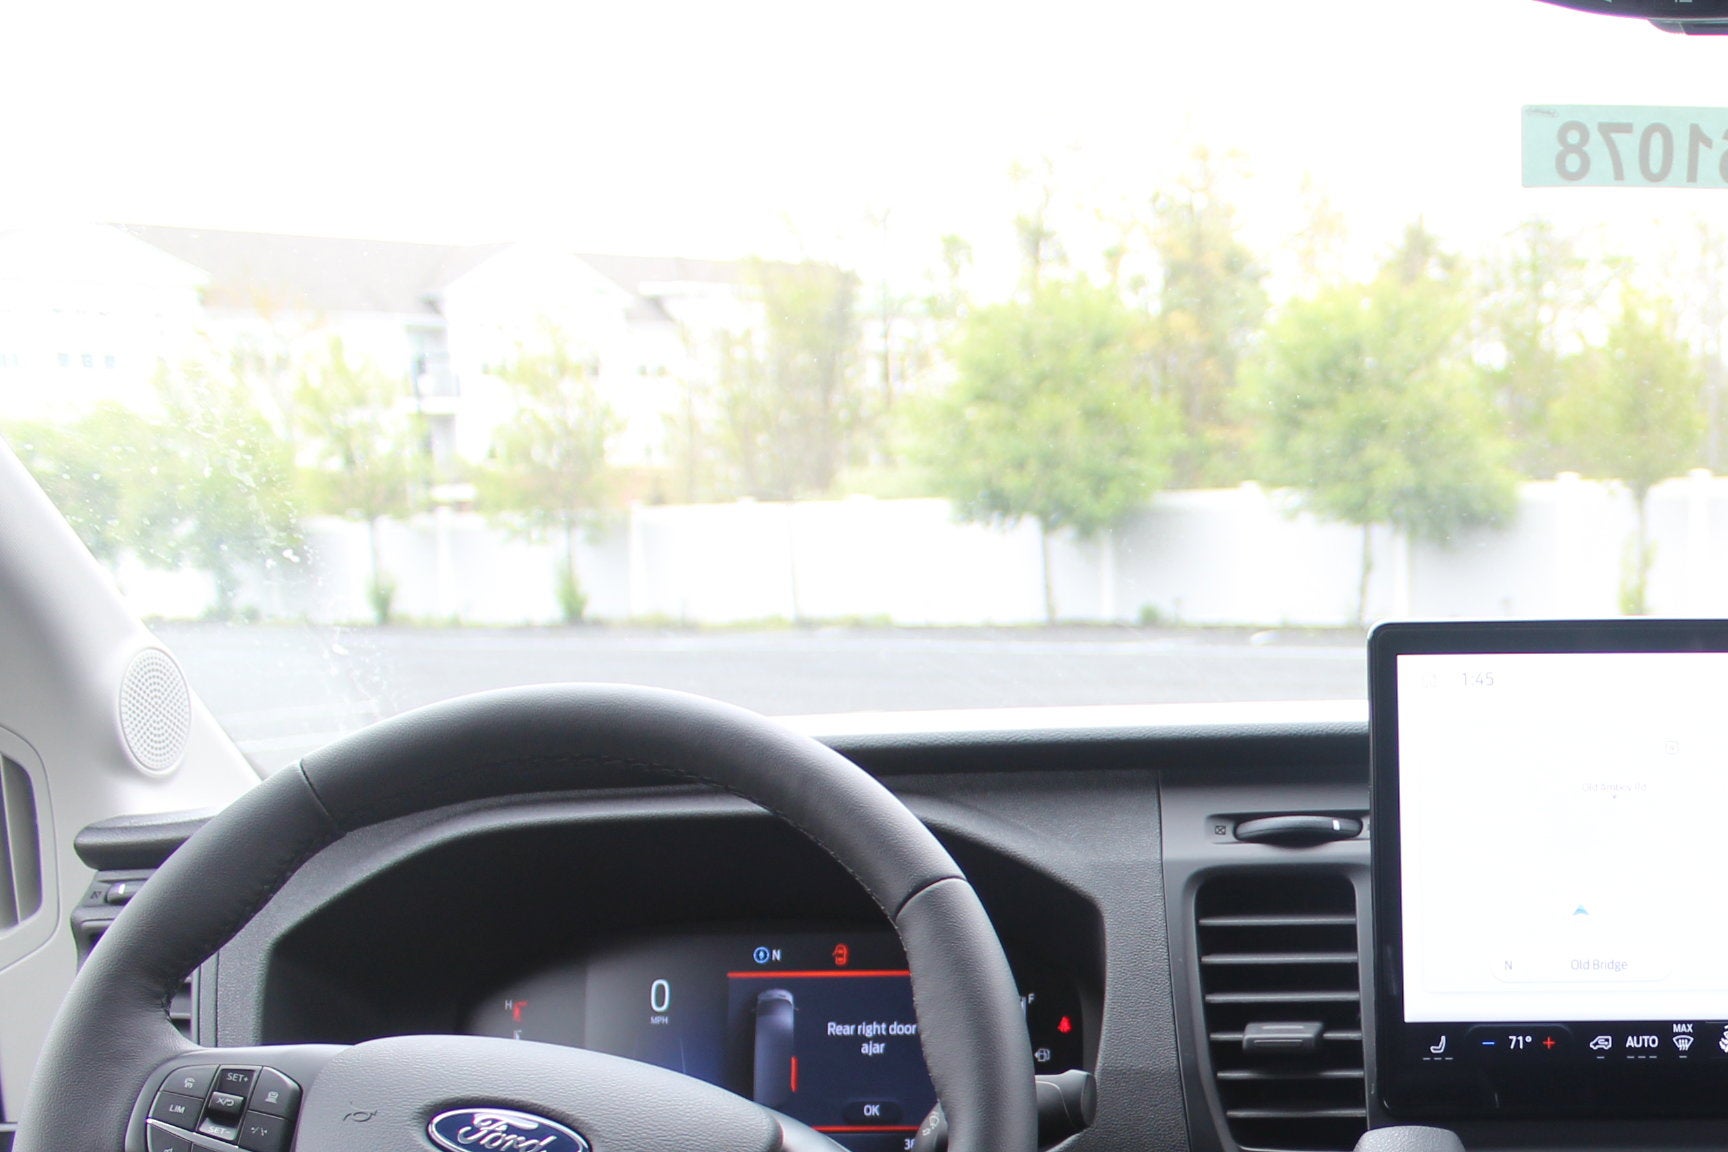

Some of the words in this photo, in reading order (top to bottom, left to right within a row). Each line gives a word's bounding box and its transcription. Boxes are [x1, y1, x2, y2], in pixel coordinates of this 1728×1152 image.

[1460, 671, 1496, 687] 1:45
[772, 949, 782, 961] N
[1504, 960, 1513, 970] N
[1570, 959, 1590, 970] Old
[1592, 959, 1629, 972] Bridge
[650, 978, 670, 1012] 0
[505, 1000, 513, 1010] H
[650, 1016, 668, 1025] MPH
[827, 1021, 855, 1036] Rear
[857, 1021, 887, 1037] right
[888, 1021, 917, 1036] door
[1673, 1024, 1693, 1033] MAX
[1508, 1035, 1532, 1049] 71°
[1625, 1035, 1659, 1048] AUTO
[861, 1041, 885, 1056] ajar
[227, 1072, 249, 1083] SET+
[169, 1104, 185, 1114] LIM
[863, 1104, 880, 1116] OK
